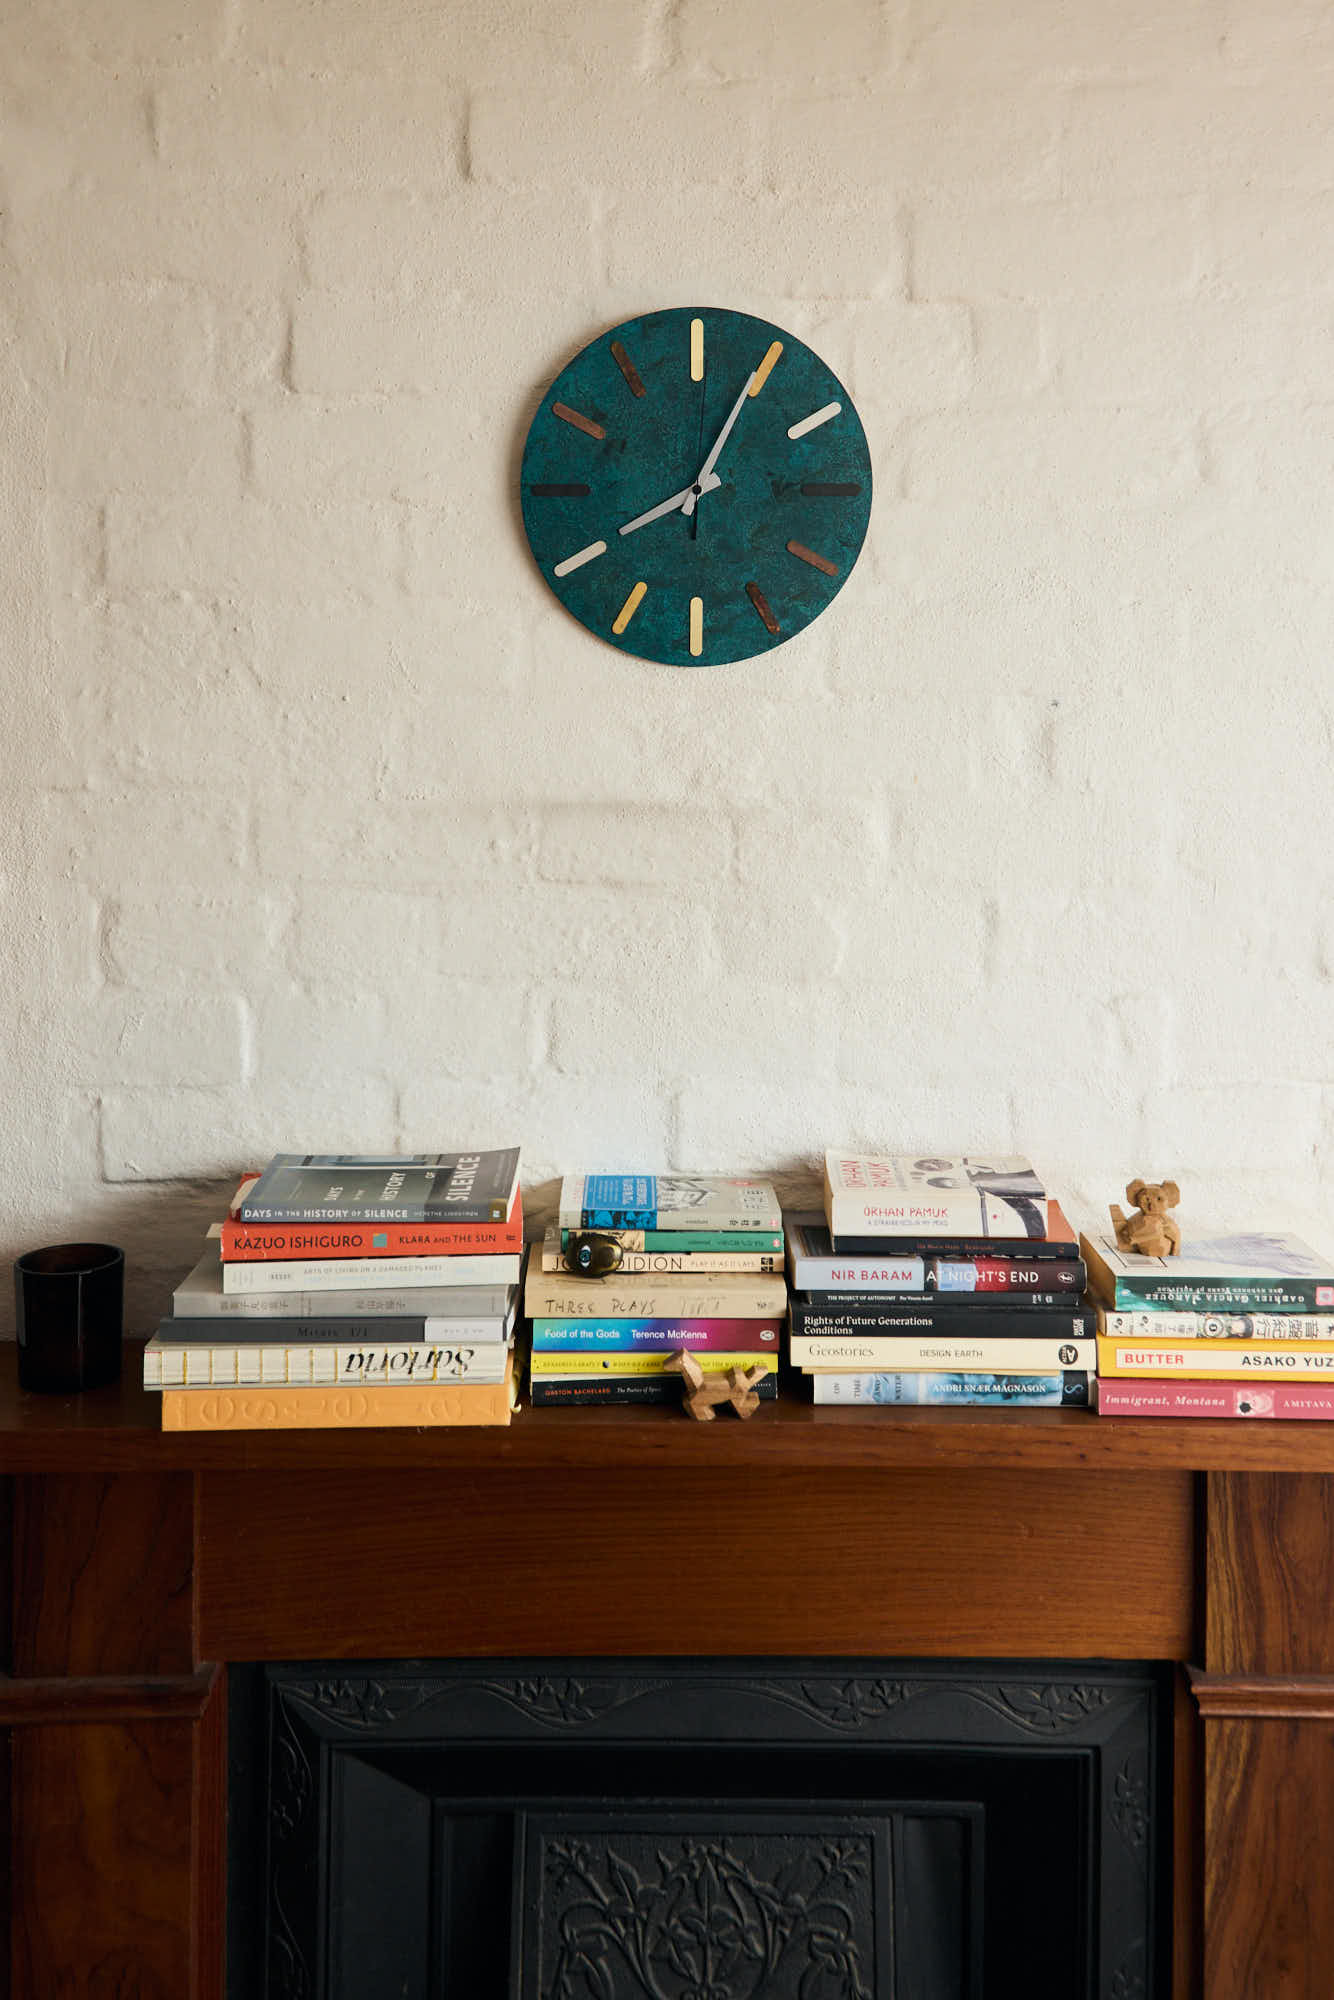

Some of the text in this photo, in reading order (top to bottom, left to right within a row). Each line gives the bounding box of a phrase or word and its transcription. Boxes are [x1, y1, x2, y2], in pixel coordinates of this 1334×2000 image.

[445, 1155, 481, 1202] SILENCE
[840, 1160, 866, 1189] ORHAN
[868, 1161, 894, 1189] PAMUK
[380, 1171, 407, 1201] HISTORY
[244, 1209, 272, 1218] DAYS
[303, 1209, 349, 1218] HISTORY
[364, 1209, 408, 1218] SILENCE
[864, 1207, 949, 1217] ORHAN PAMUK
[233, 1235, 363, 1250] KAZUO ISHIGURO
[399, 1236, 431, 1245] KLARA
[453, 1235, 472, 1243] THE
[475, 1234, 497, 1243] SUN
[831, 1270, 912, 1281] NIR BARAM
[926, 1272, 1039, 1283] AT NIGHT'S END
[544, 1298, 656, 1315] THREE PLAYS
[804, 1316, 933, 1327] Rights of Future Generations
[545, 1329, 620, 1338] Food of the Gods
[631, 1329, 708, 1340] Terence McKenna
[804, 1326, 853, 1336] Conditions
[809, 1343, 874, 1357] Geostories
[919, 1349, 983, 1358] DESIGN EARTH
[346, 1349, 475, 1375] Sartoria
[1124, 1353, 1184, 1365] BUTTER
[1241, 1356, 1334, 1367] ASAKO YUZ
[573, 1387, 611, 1395] BACHELARD
[934, 1383, 962, 1393] ANDRI
[992, 1383, 1047, 1393] MAGNASON
[1105, 1395, 1226, 1406] Immigrant, Montana
[1282, 1400, 1333, 1408] AMITAVA
